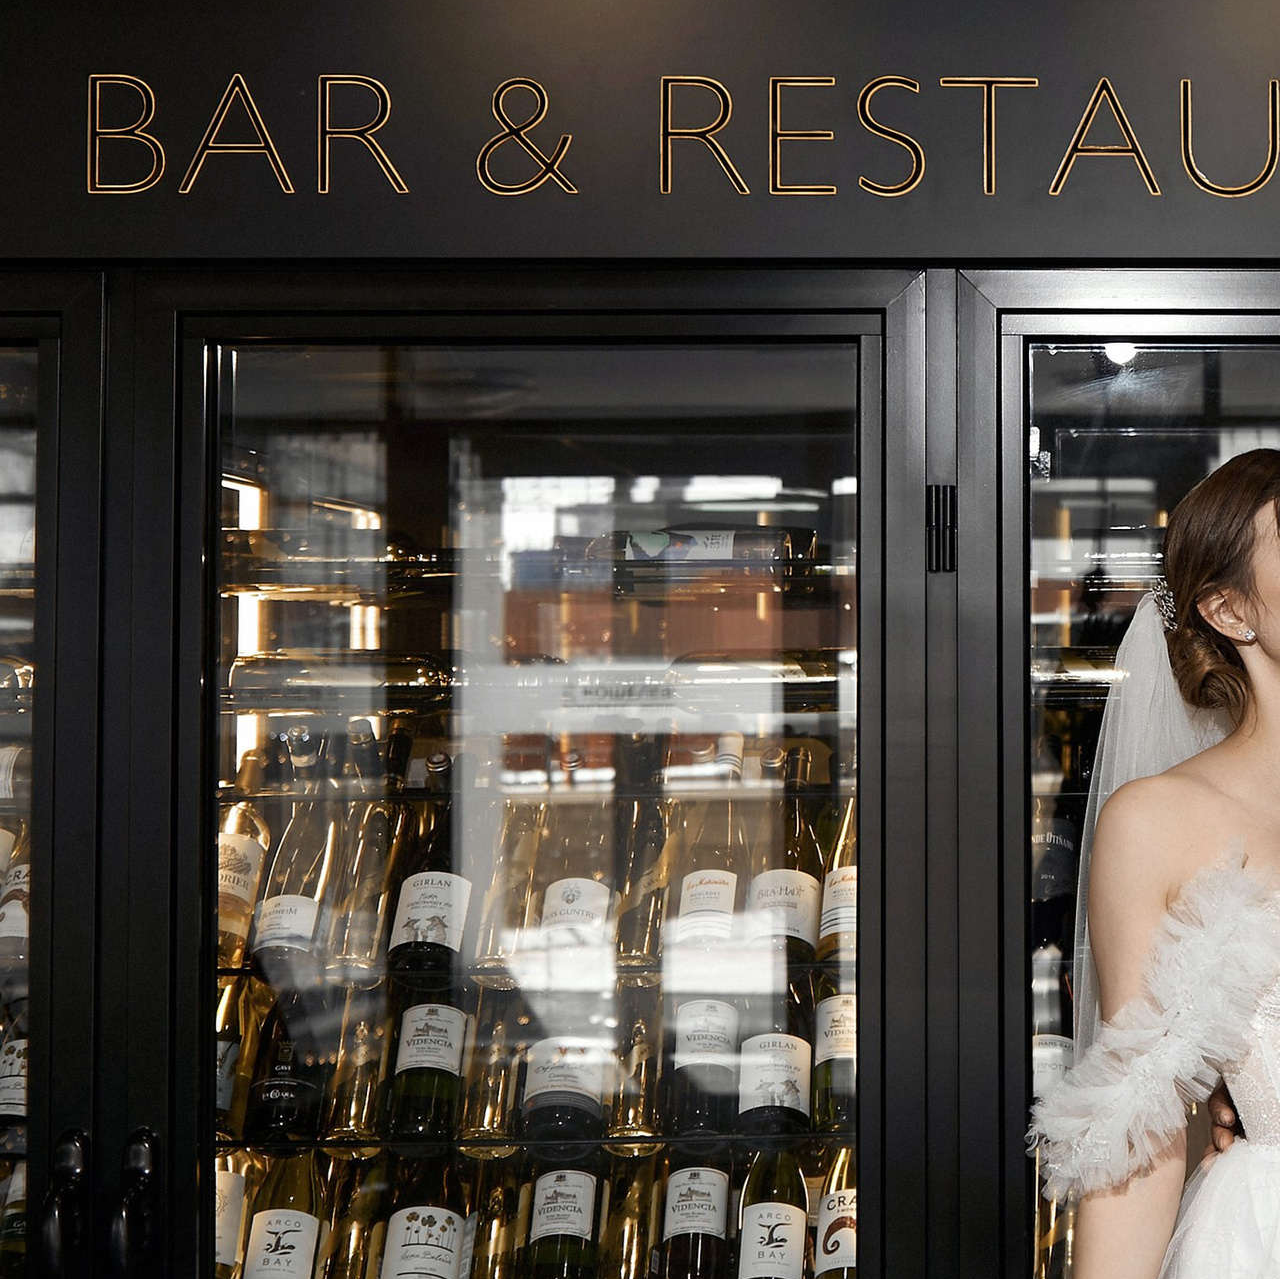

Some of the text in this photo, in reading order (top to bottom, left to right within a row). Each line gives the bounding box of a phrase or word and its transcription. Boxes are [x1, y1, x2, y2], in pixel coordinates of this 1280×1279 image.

[87, 73, 410, 196] BAR
[476, 77, 579, 197] &
[412, 878, 452, 889] GIRLAN
[405, 1038, 453, 1049] VIDENCIA
[685, 1034, 732, 1045] VIDENCIA
[759, 1040, 798, 1052] GIRLAN
[537, 1204, 583, 1216] VIDENCIA
[671, 1203, 717, 1214] VIDENCIA
[757, 1212, 792, 1222] ARCO
[265, 1218, 302, 1228] ARCO
[757, 1251, 787, 1261] BAY
[261, 1257, 293, 1268] BAY
